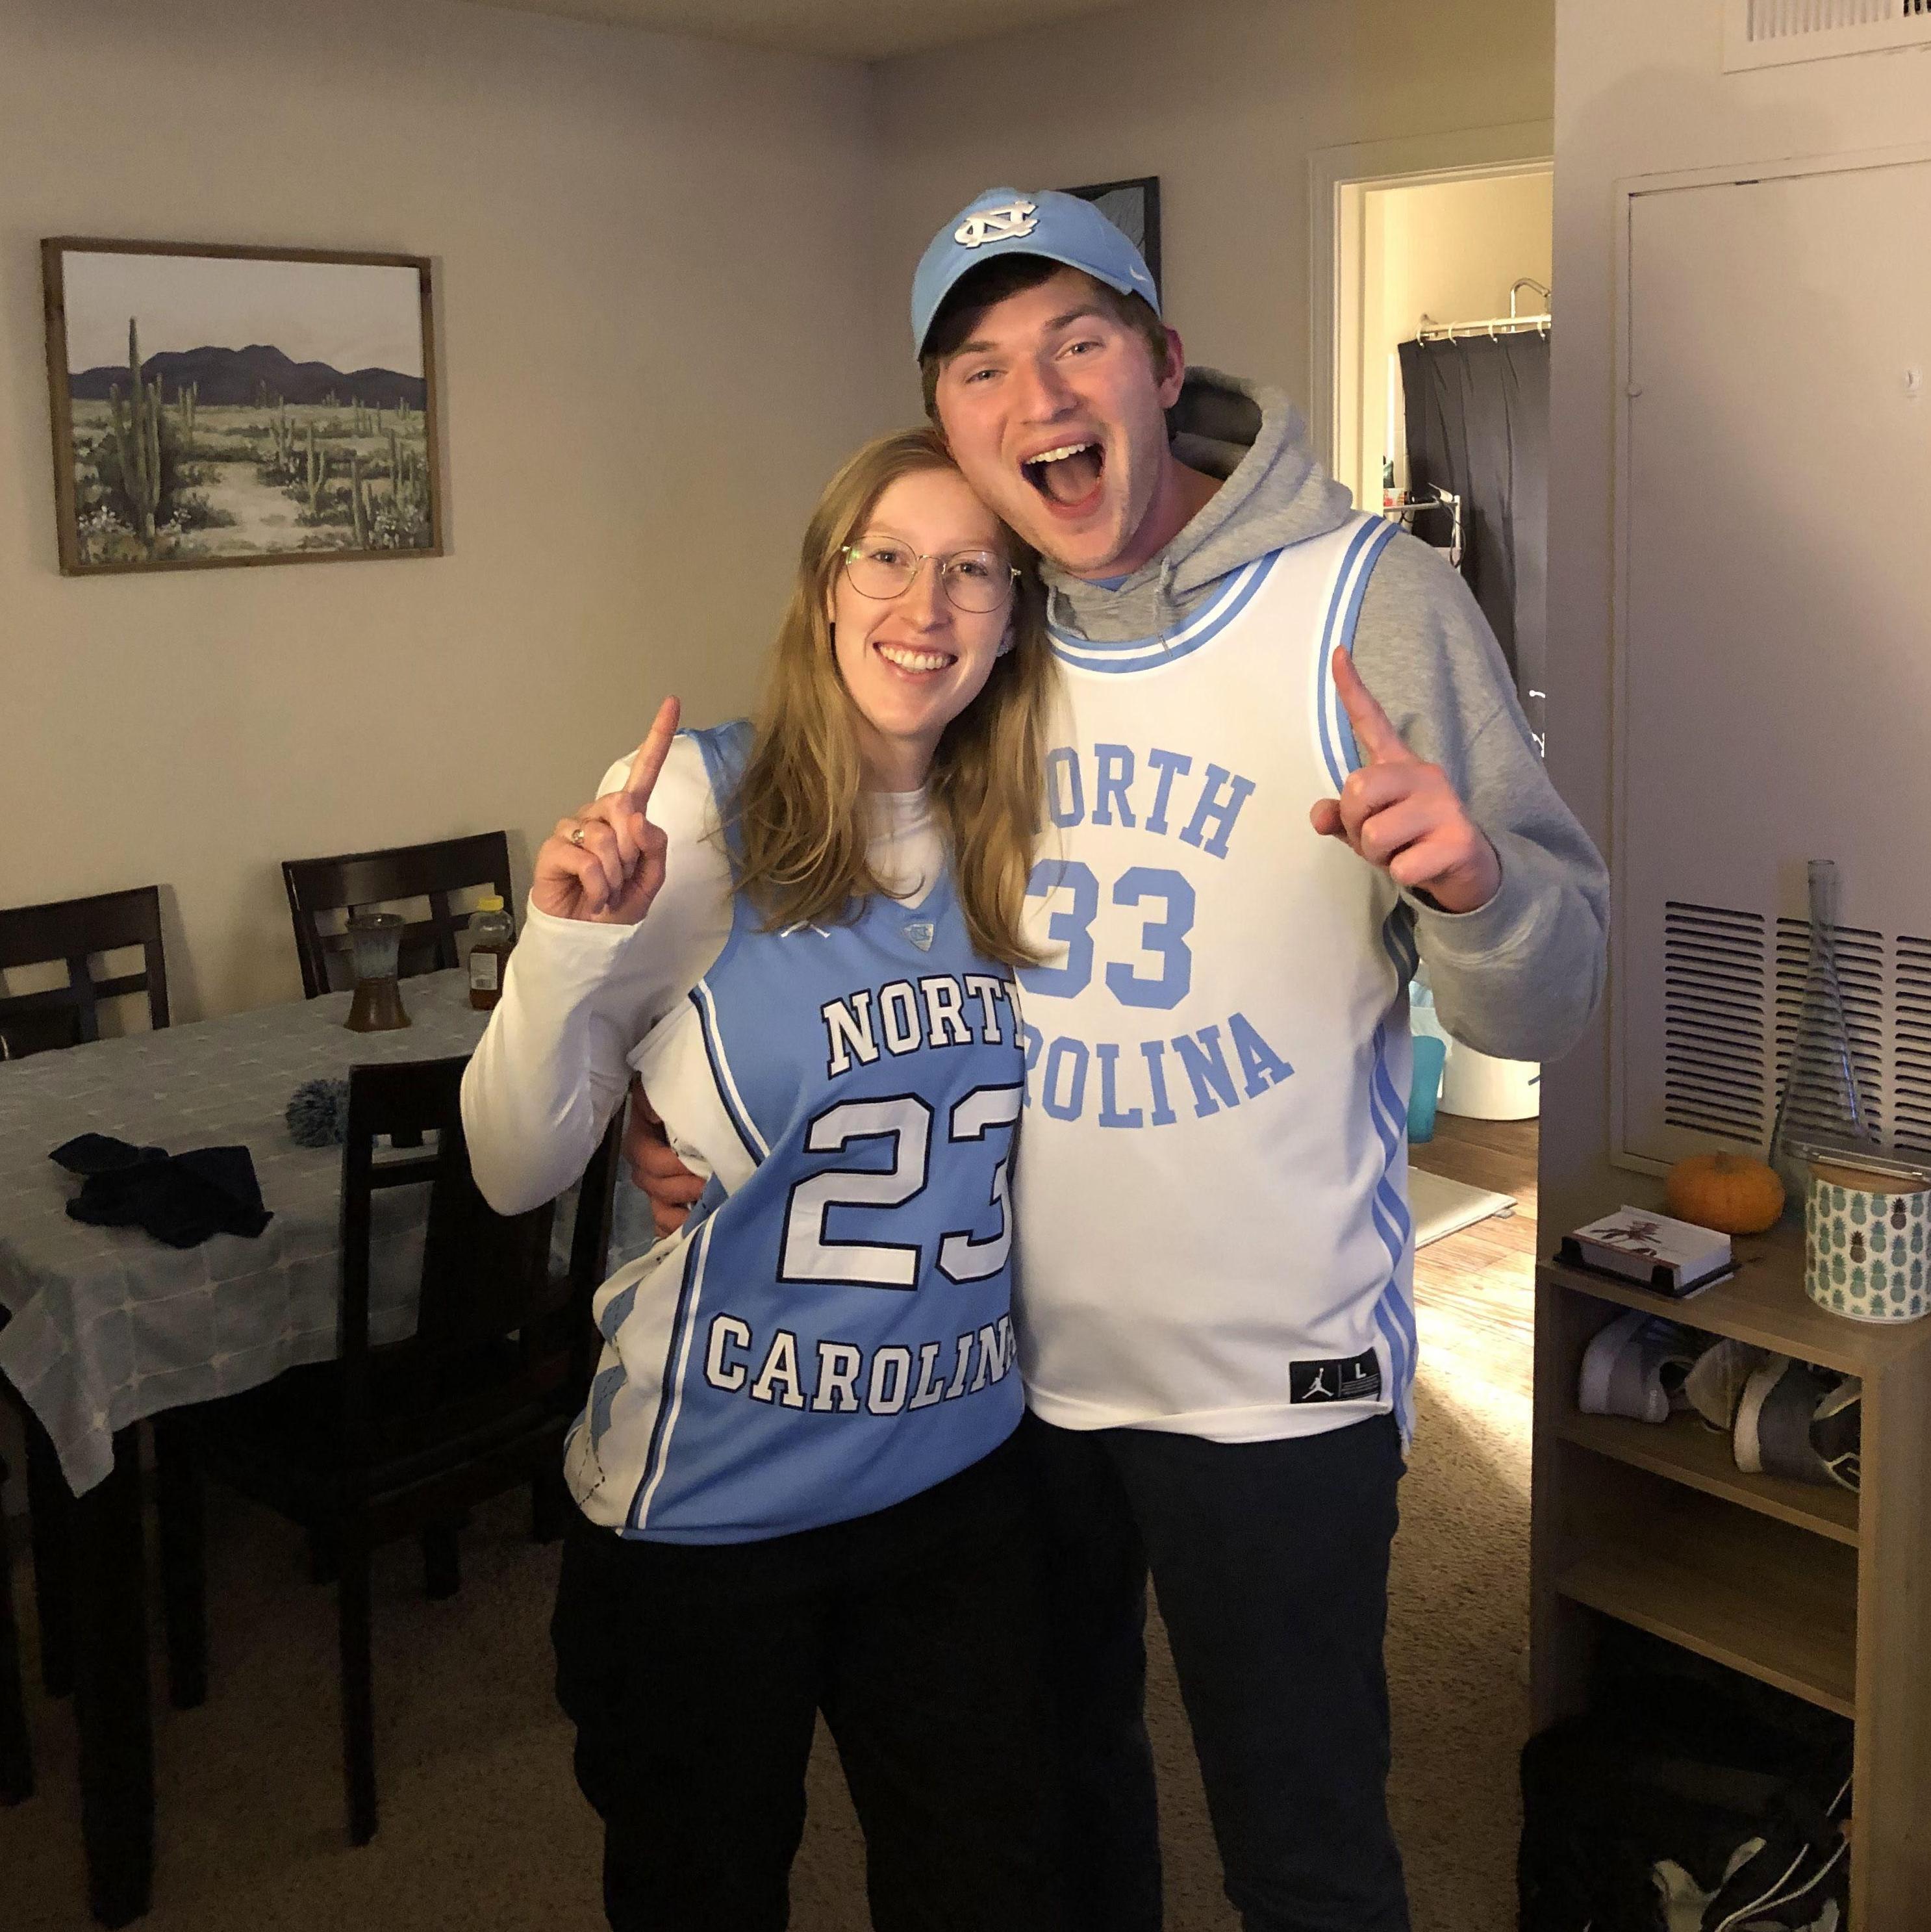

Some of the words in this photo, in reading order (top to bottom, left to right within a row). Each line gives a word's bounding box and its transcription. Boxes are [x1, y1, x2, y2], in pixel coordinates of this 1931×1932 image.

[1029, 743, 1256, 859] ORTH
[1015, 858, 1196, 1010] 33
[776, 1081, 1024, 1291] 23
[1355, 1363, 1367, 1379] L
